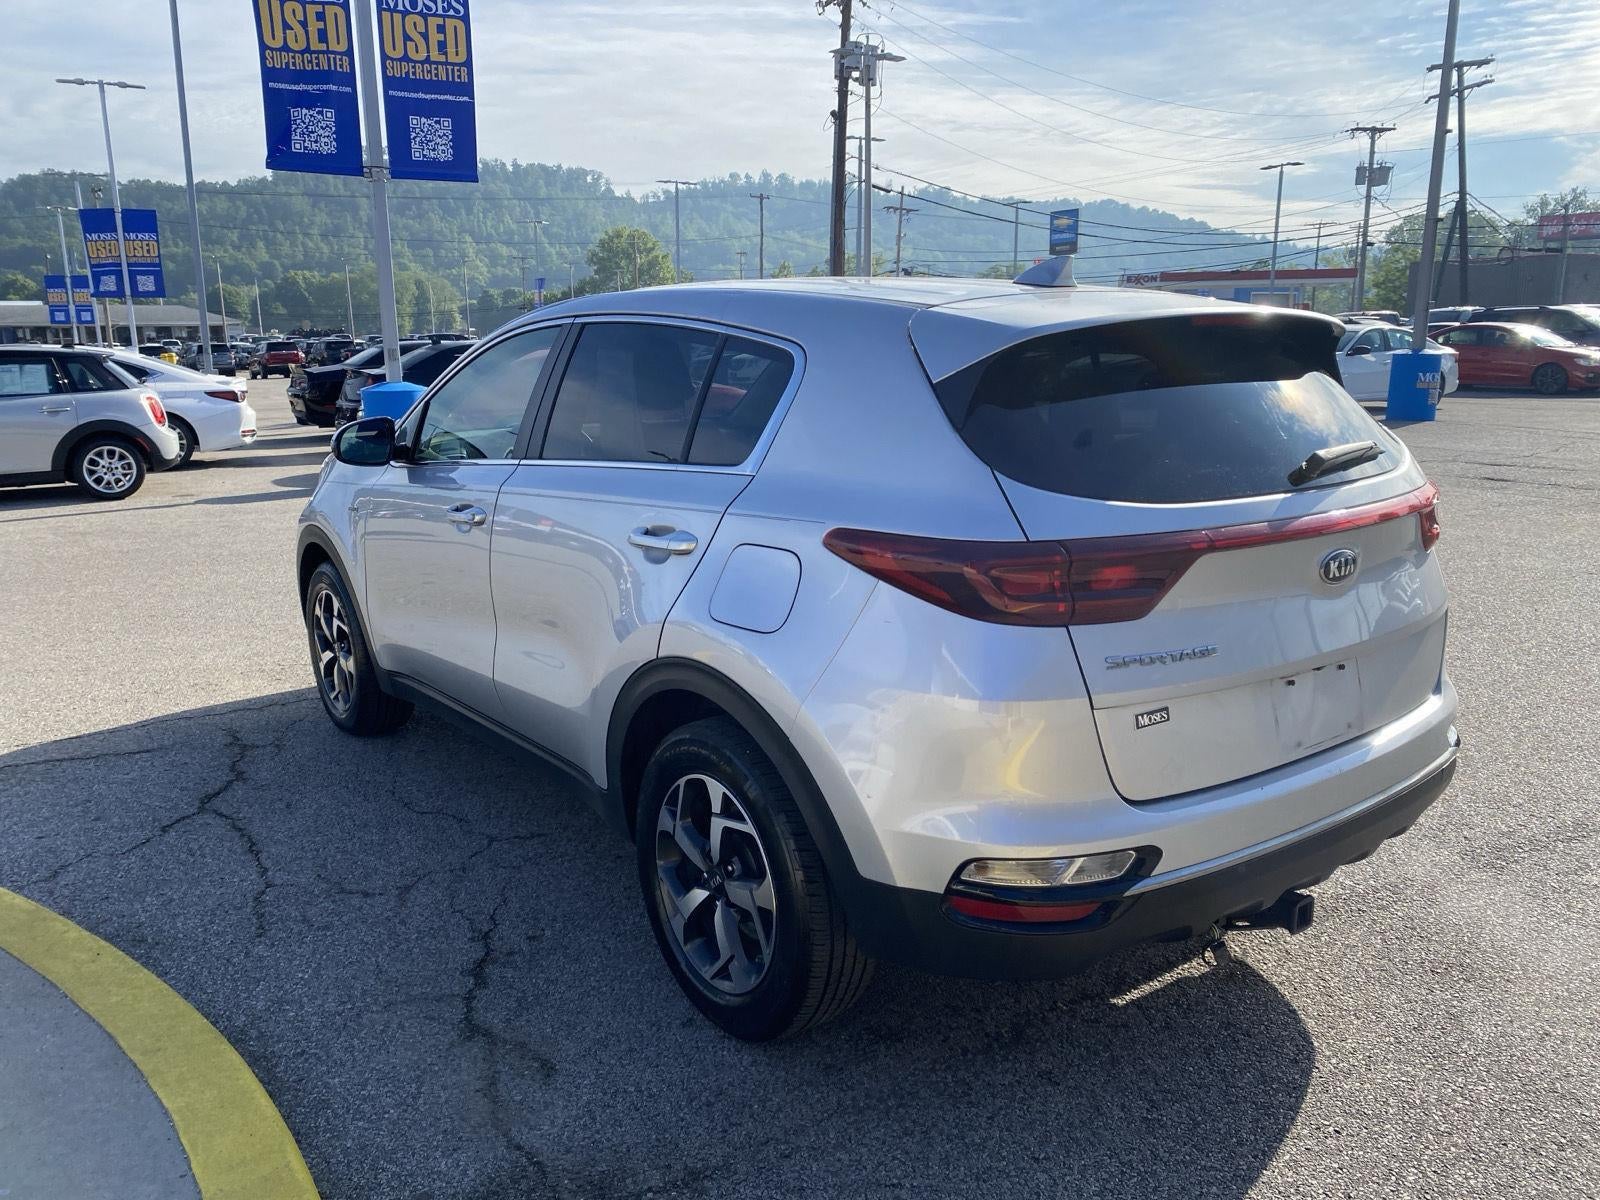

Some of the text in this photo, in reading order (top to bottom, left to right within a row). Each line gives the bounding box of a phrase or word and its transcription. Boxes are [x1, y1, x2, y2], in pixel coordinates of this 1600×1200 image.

[258, 0, 349, 52] USED
[382, 11, 467, 63] USED
[265, 49, 350, 72] SUPERCENTER
[386, 60, 468, 82] SUPERCENTER
[268, 81, 352, 93] mosesusedsupercenter.com
[85, 232, 118, 240] MOSES
[124, 232, 157, 241] MOSES
[87, 241, 119, 257] USED
[125, 241, 158, 257] USED
[1127, 274, 1157, 285] EXXON
[1328, 557, 1354, 578] KIA
[1105, 643, 1219, 670] SPORTAGE
[1137, 710, 1168, 726] MOSES
